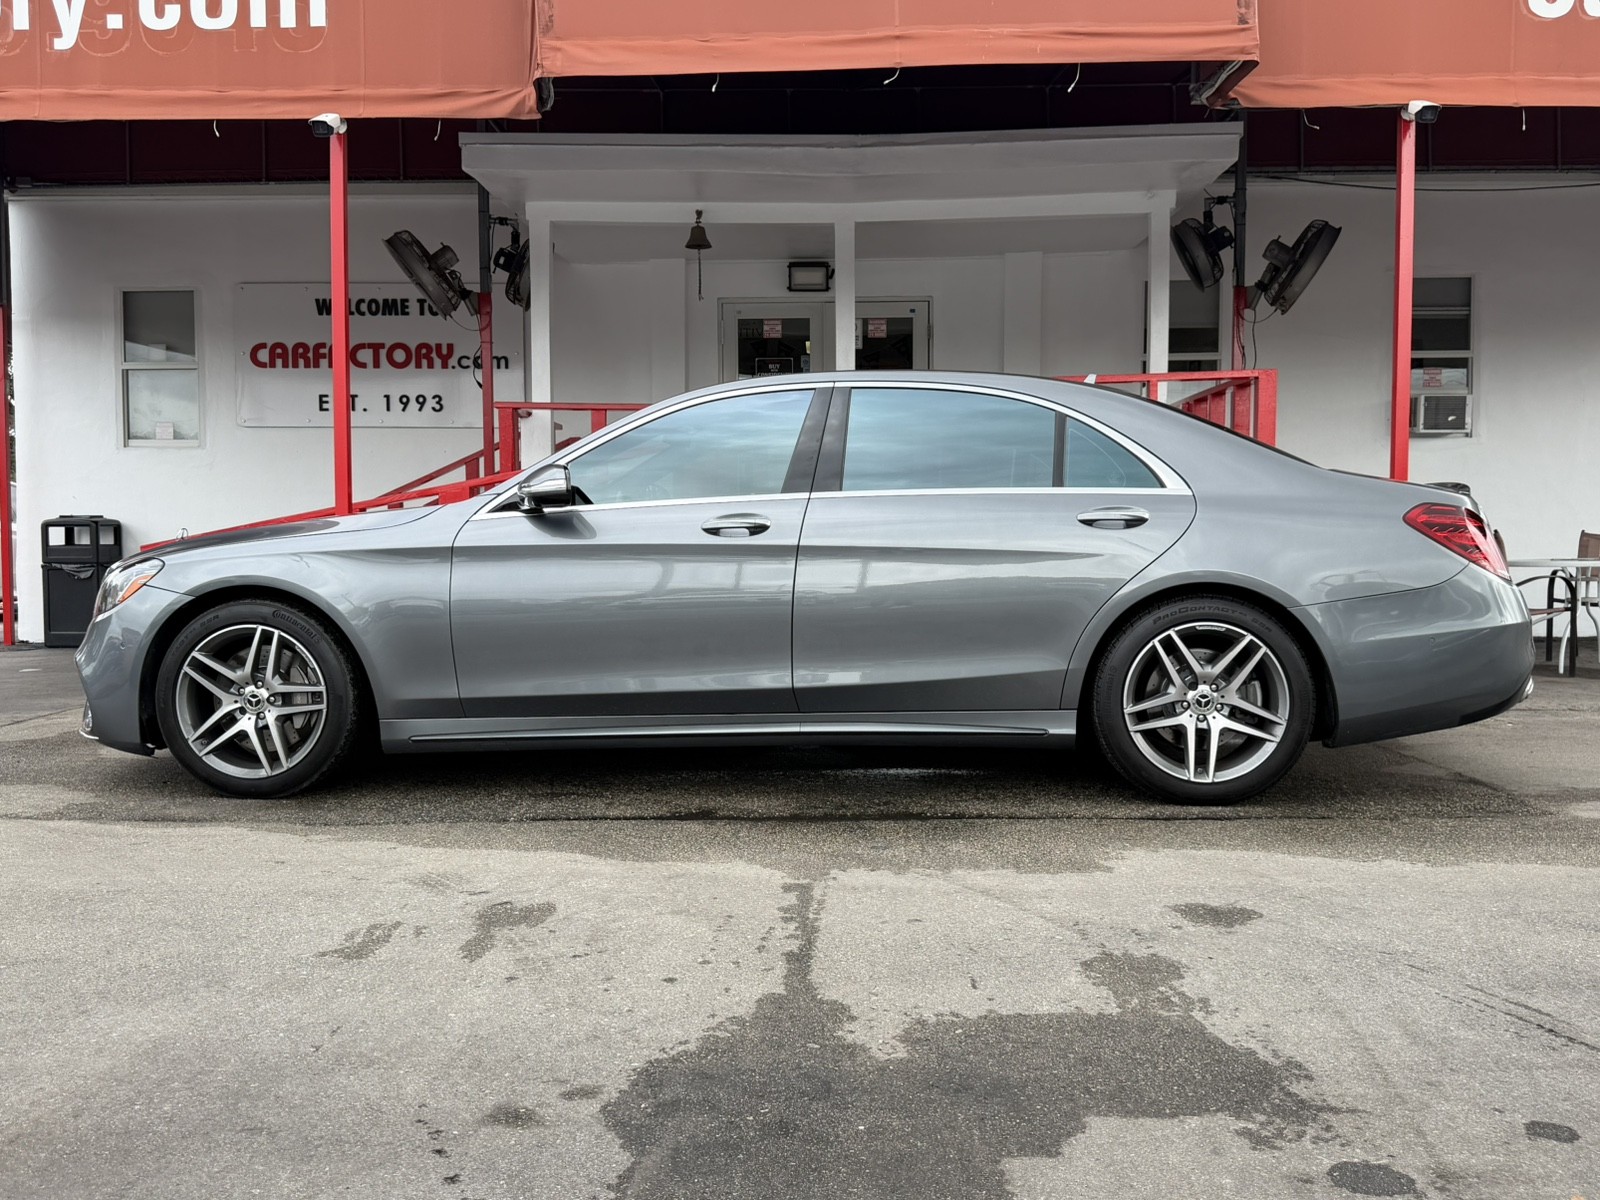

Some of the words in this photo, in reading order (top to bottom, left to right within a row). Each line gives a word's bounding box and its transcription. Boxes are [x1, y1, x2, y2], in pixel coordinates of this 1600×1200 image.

[314, 298, 410, 316] WLCOME
[250, 342, 509, 369] CARFCTORY.cm
[318, 394, 367, 412] ET.
[383, 394, 444, 413] 1993
[272, 610, 317, 640] Continental
